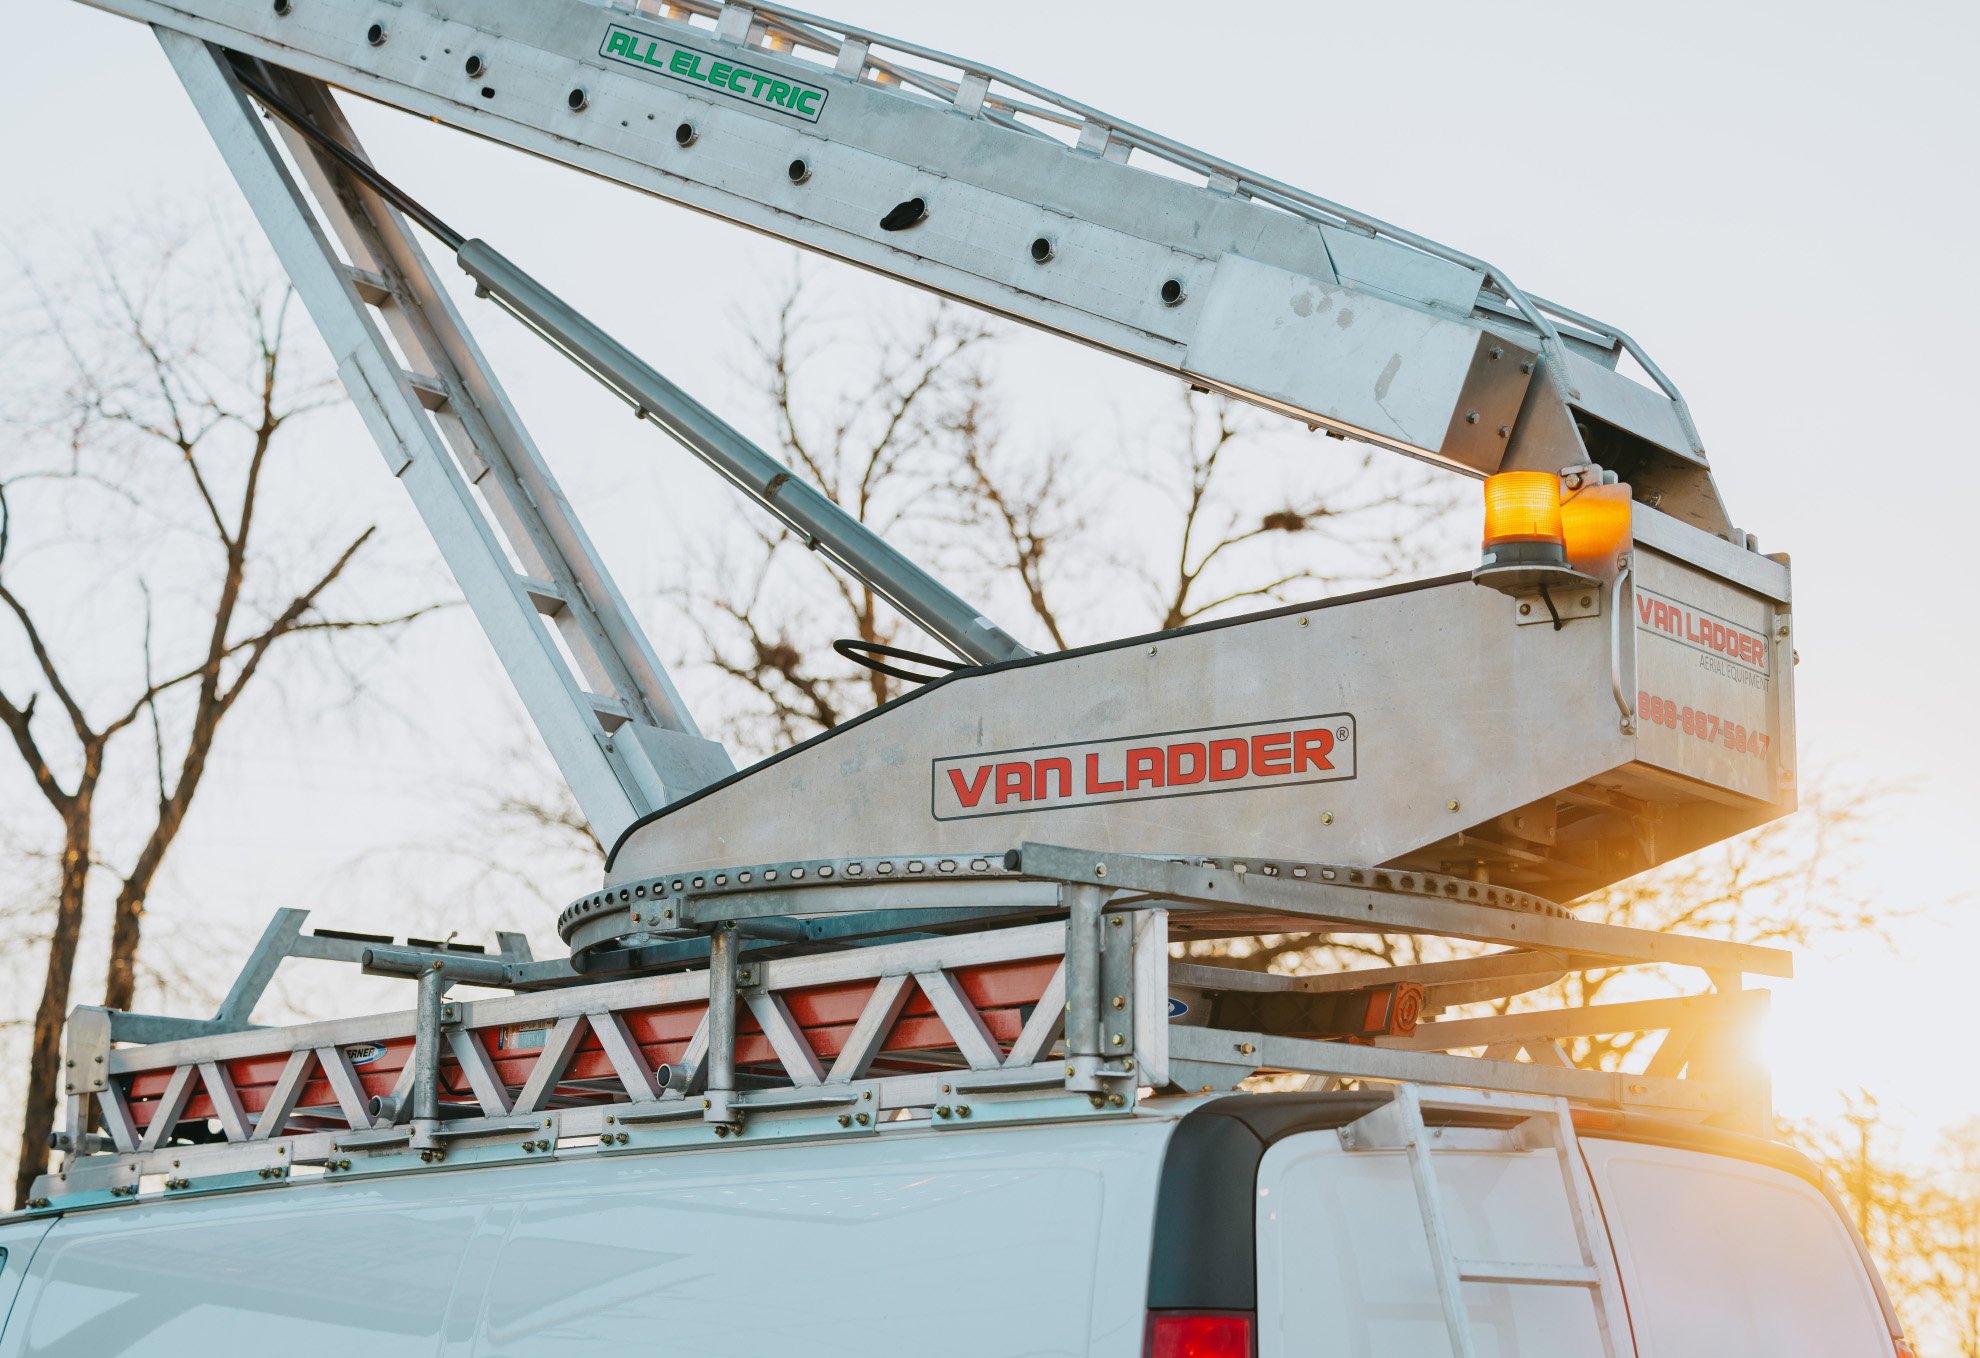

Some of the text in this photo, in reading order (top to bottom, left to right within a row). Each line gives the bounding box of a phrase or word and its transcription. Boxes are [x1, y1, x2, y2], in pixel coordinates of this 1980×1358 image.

[606, 31, 822, 116] ALL ELECTRIC
[1636, 593, 1682, 637] VAN
[1699, 654, 1770, 693] AERIAL EQUIPMENT
[1637, 690, 1771, 761] 888-887-5847
[947, 757, 1072, 808] VAN
[346, 1047, 375, 1059] ERNER
